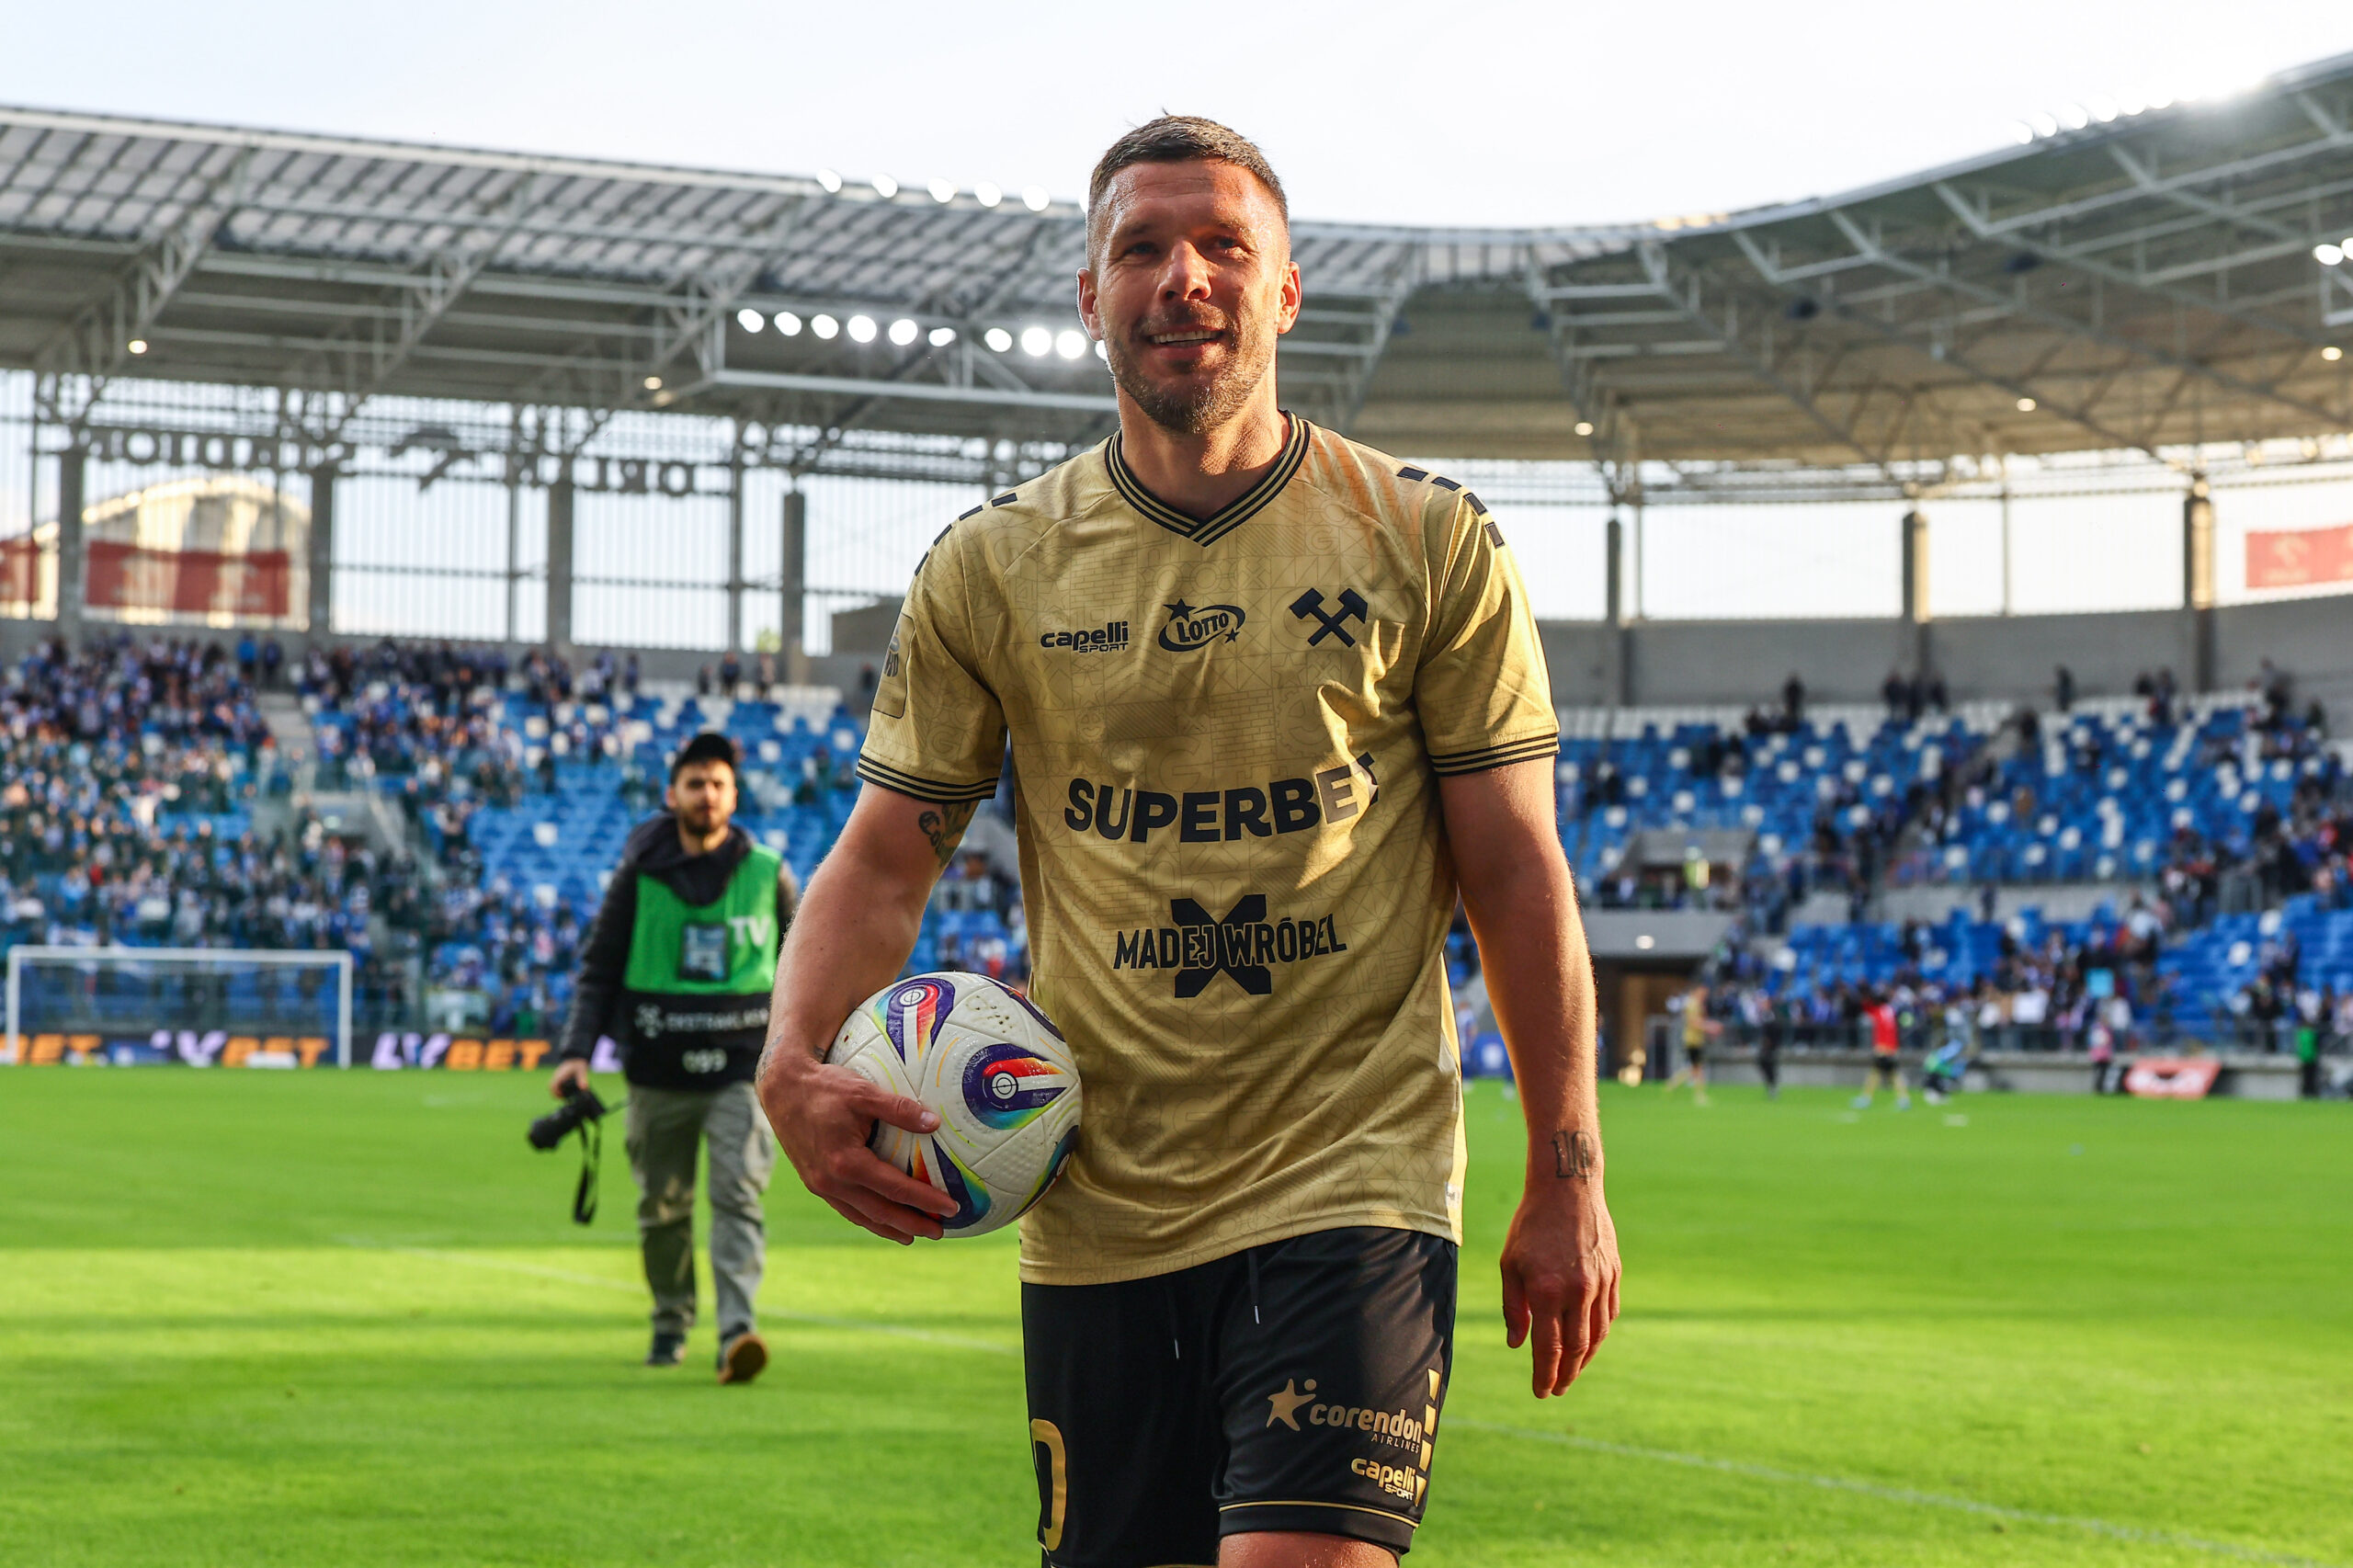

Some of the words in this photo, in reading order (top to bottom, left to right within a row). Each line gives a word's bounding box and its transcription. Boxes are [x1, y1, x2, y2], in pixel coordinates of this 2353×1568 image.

[1040, 620, 1129, 652] capelli
[1176, 612, 1230, 643] LOTTO
[1078, 642, 1129, 653] SPORT
[727, 915, 771, 947] TV
[1112, 924, 1216, 970] MADEJ
[1223, 913, 1347, 969] WRÓBEL
[1309, 1403, 1424, 1444] corendon
[1370, 1433, 1420, 1454] AIRLINES
[1350, 1457, 1417, 1493] capelli
[1384, 1483, 1415, 1501] SPORT
